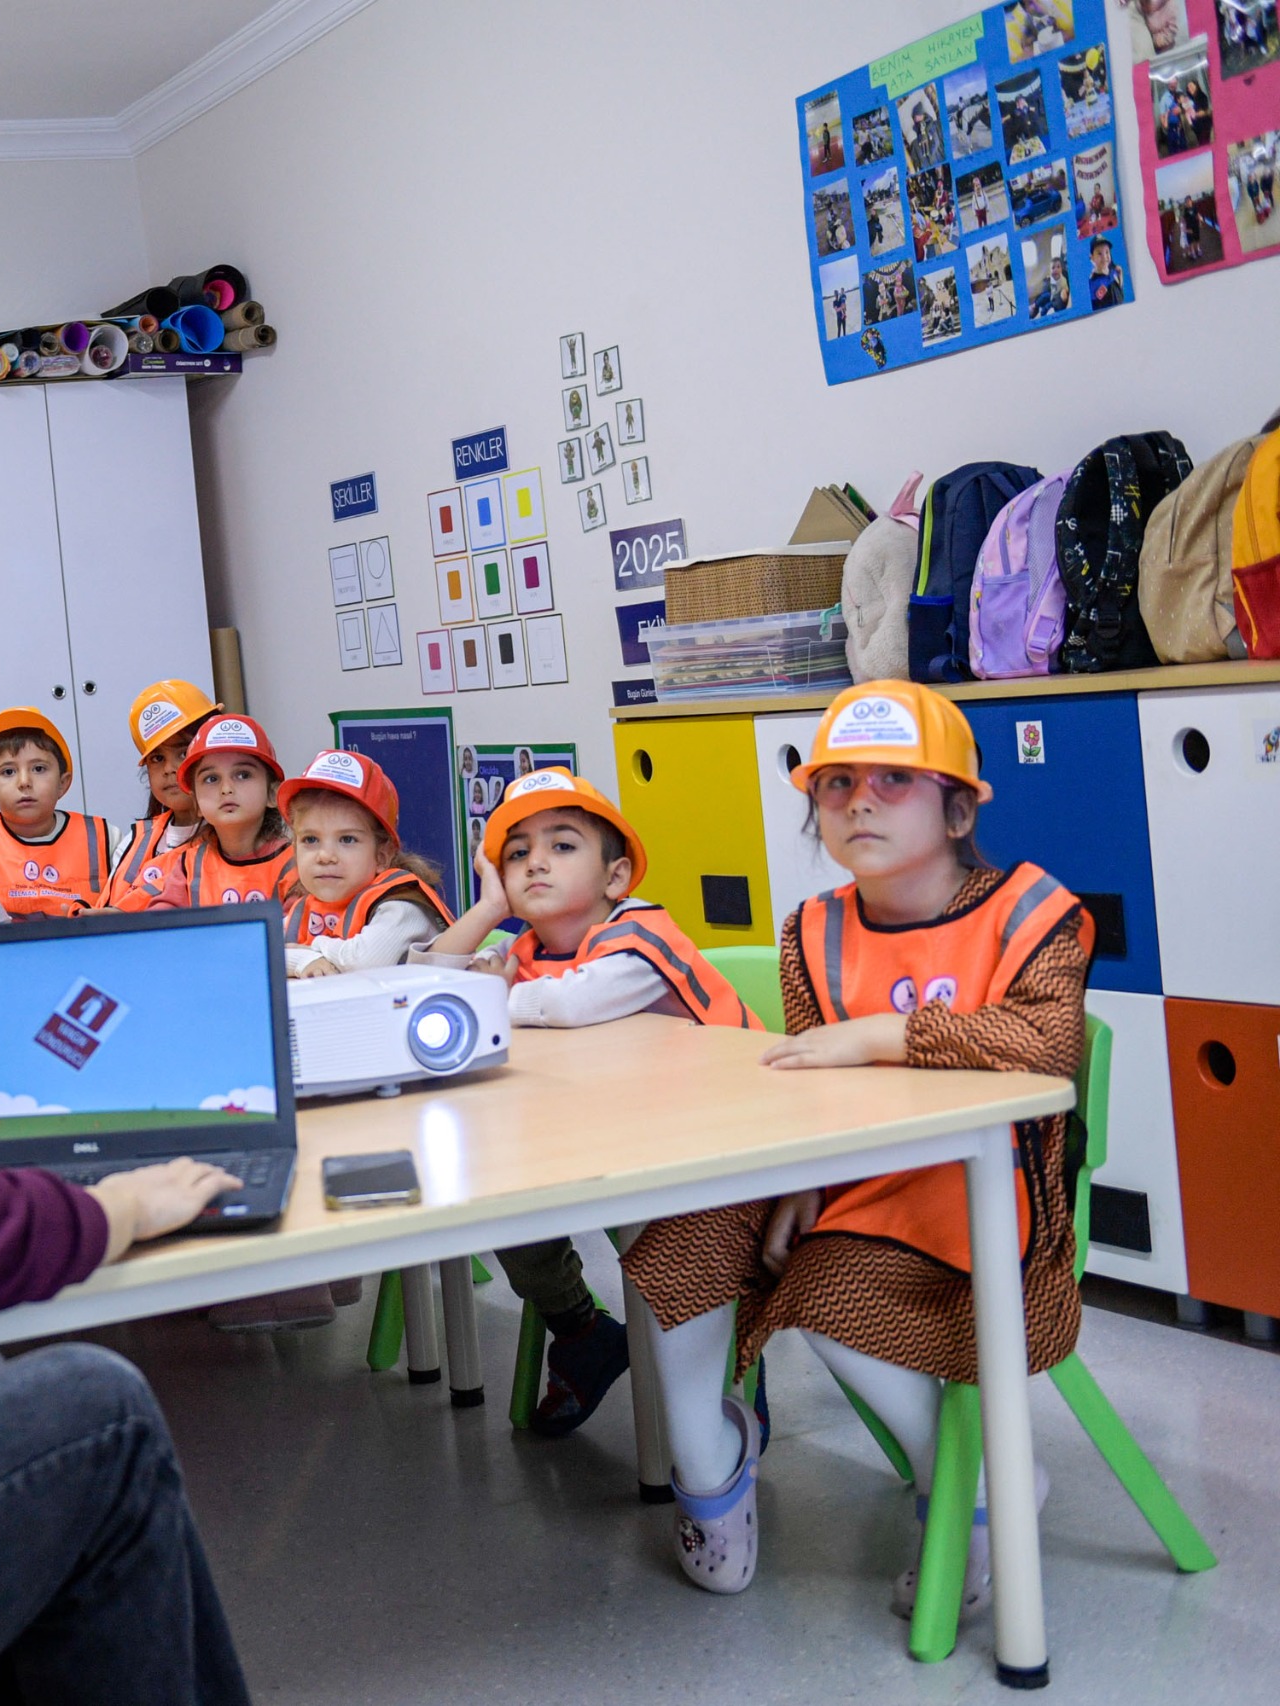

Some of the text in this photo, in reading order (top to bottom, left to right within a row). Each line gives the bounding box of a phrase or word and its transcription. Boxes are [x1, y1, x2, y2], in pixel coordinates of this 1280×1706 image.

[455, 436, 504, 467] RENKLER
[332, 481, 373, 512] ŞEKİLLER
[615, 530, 683, 578] 2025
[626, 689, 640, 701] Bugün
[370, 731, 386, 742] Bugün
[387, 731, 399, 740] hava
[479, 765, 499, 775] Okulda
[73, 1142, 99, 1154] DELL
